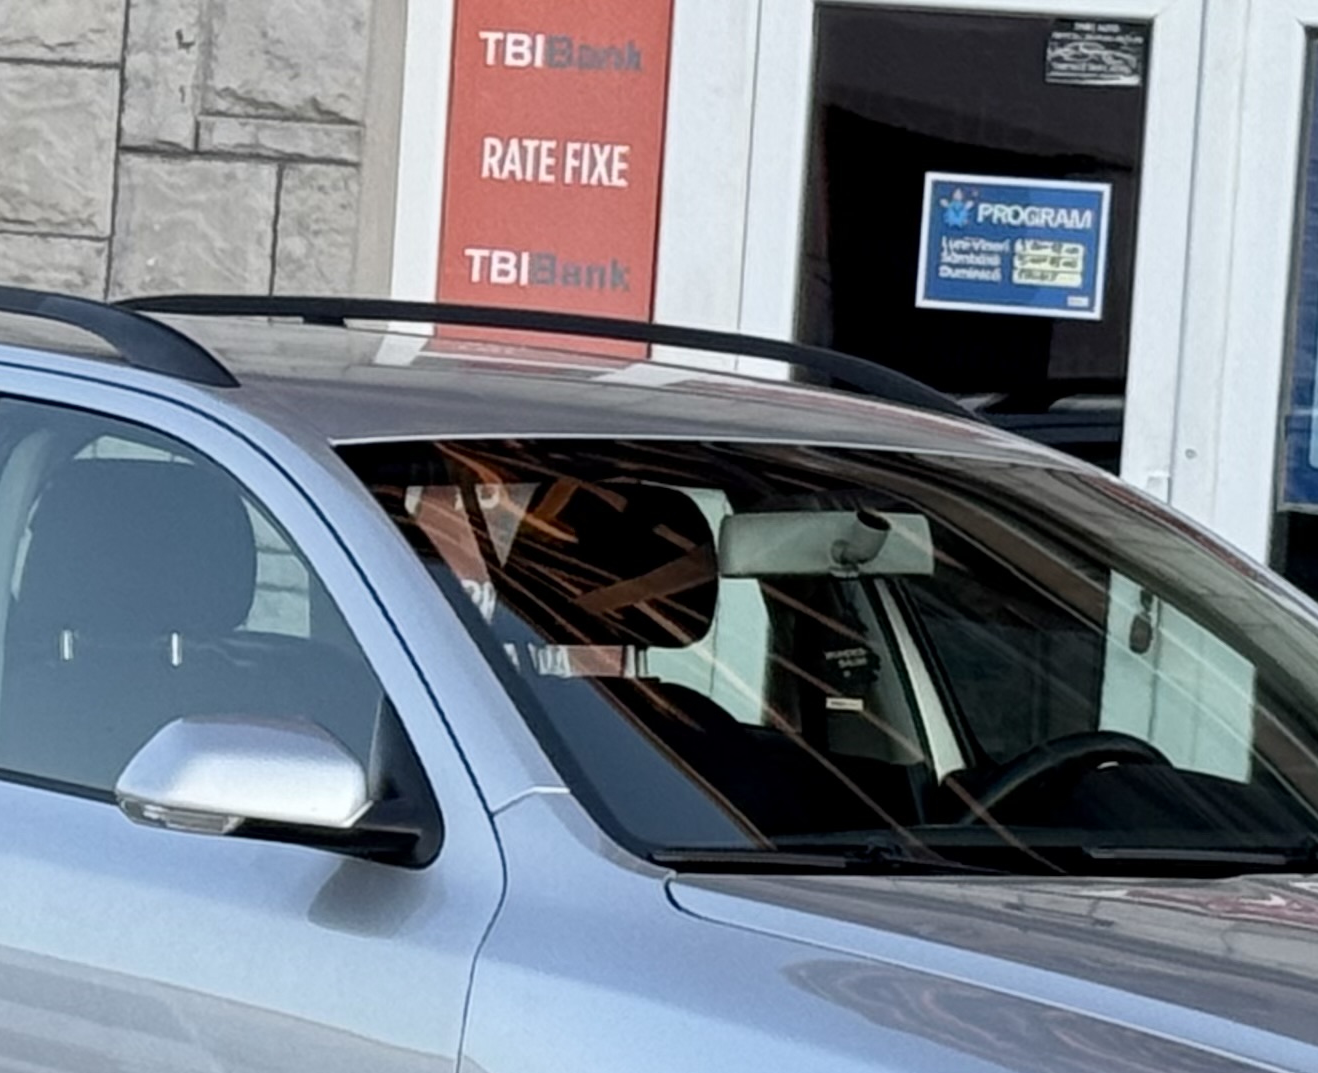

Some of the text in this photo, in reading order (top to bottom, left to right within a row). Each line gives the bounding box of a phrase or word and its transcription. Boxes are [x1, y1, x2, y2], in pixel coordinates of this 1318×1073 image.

[481, 136, 630, 187] RATE FIXE
[977, 202, 1093, 229] PROGRAM
